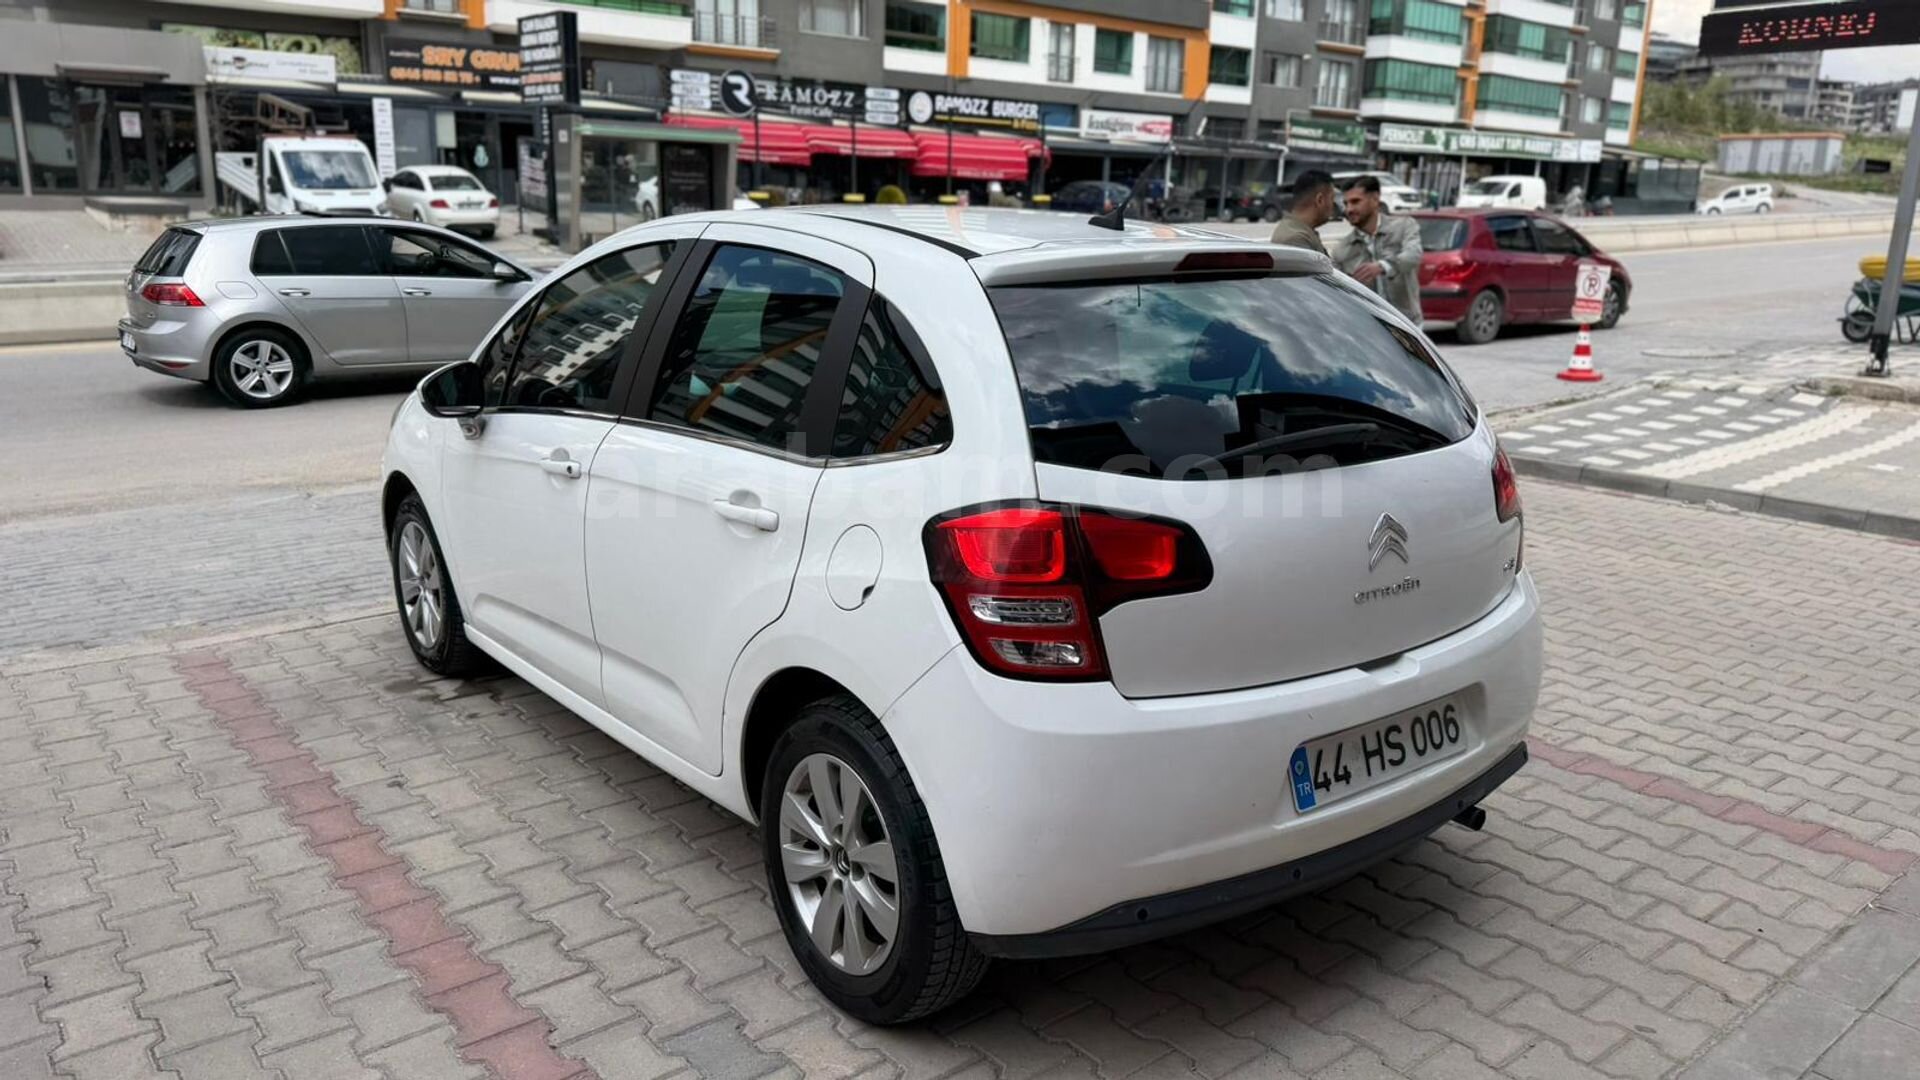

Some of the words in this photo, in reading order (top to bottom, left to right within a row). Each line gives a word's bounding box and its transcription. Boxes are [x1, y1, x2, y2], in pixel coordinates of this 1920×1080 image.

[765, 83, 855, 108] RAMOZZ
[934, 94, 989, 116] RAMOZZ
[992, 100, 1039, 119] BURGER
[1314, 742, 1352, 792] 44
[1360, 724, 1406, 777] HS
[1410, 704, 1460, 757] 006
[1297, 783, 1312, 796] TR
